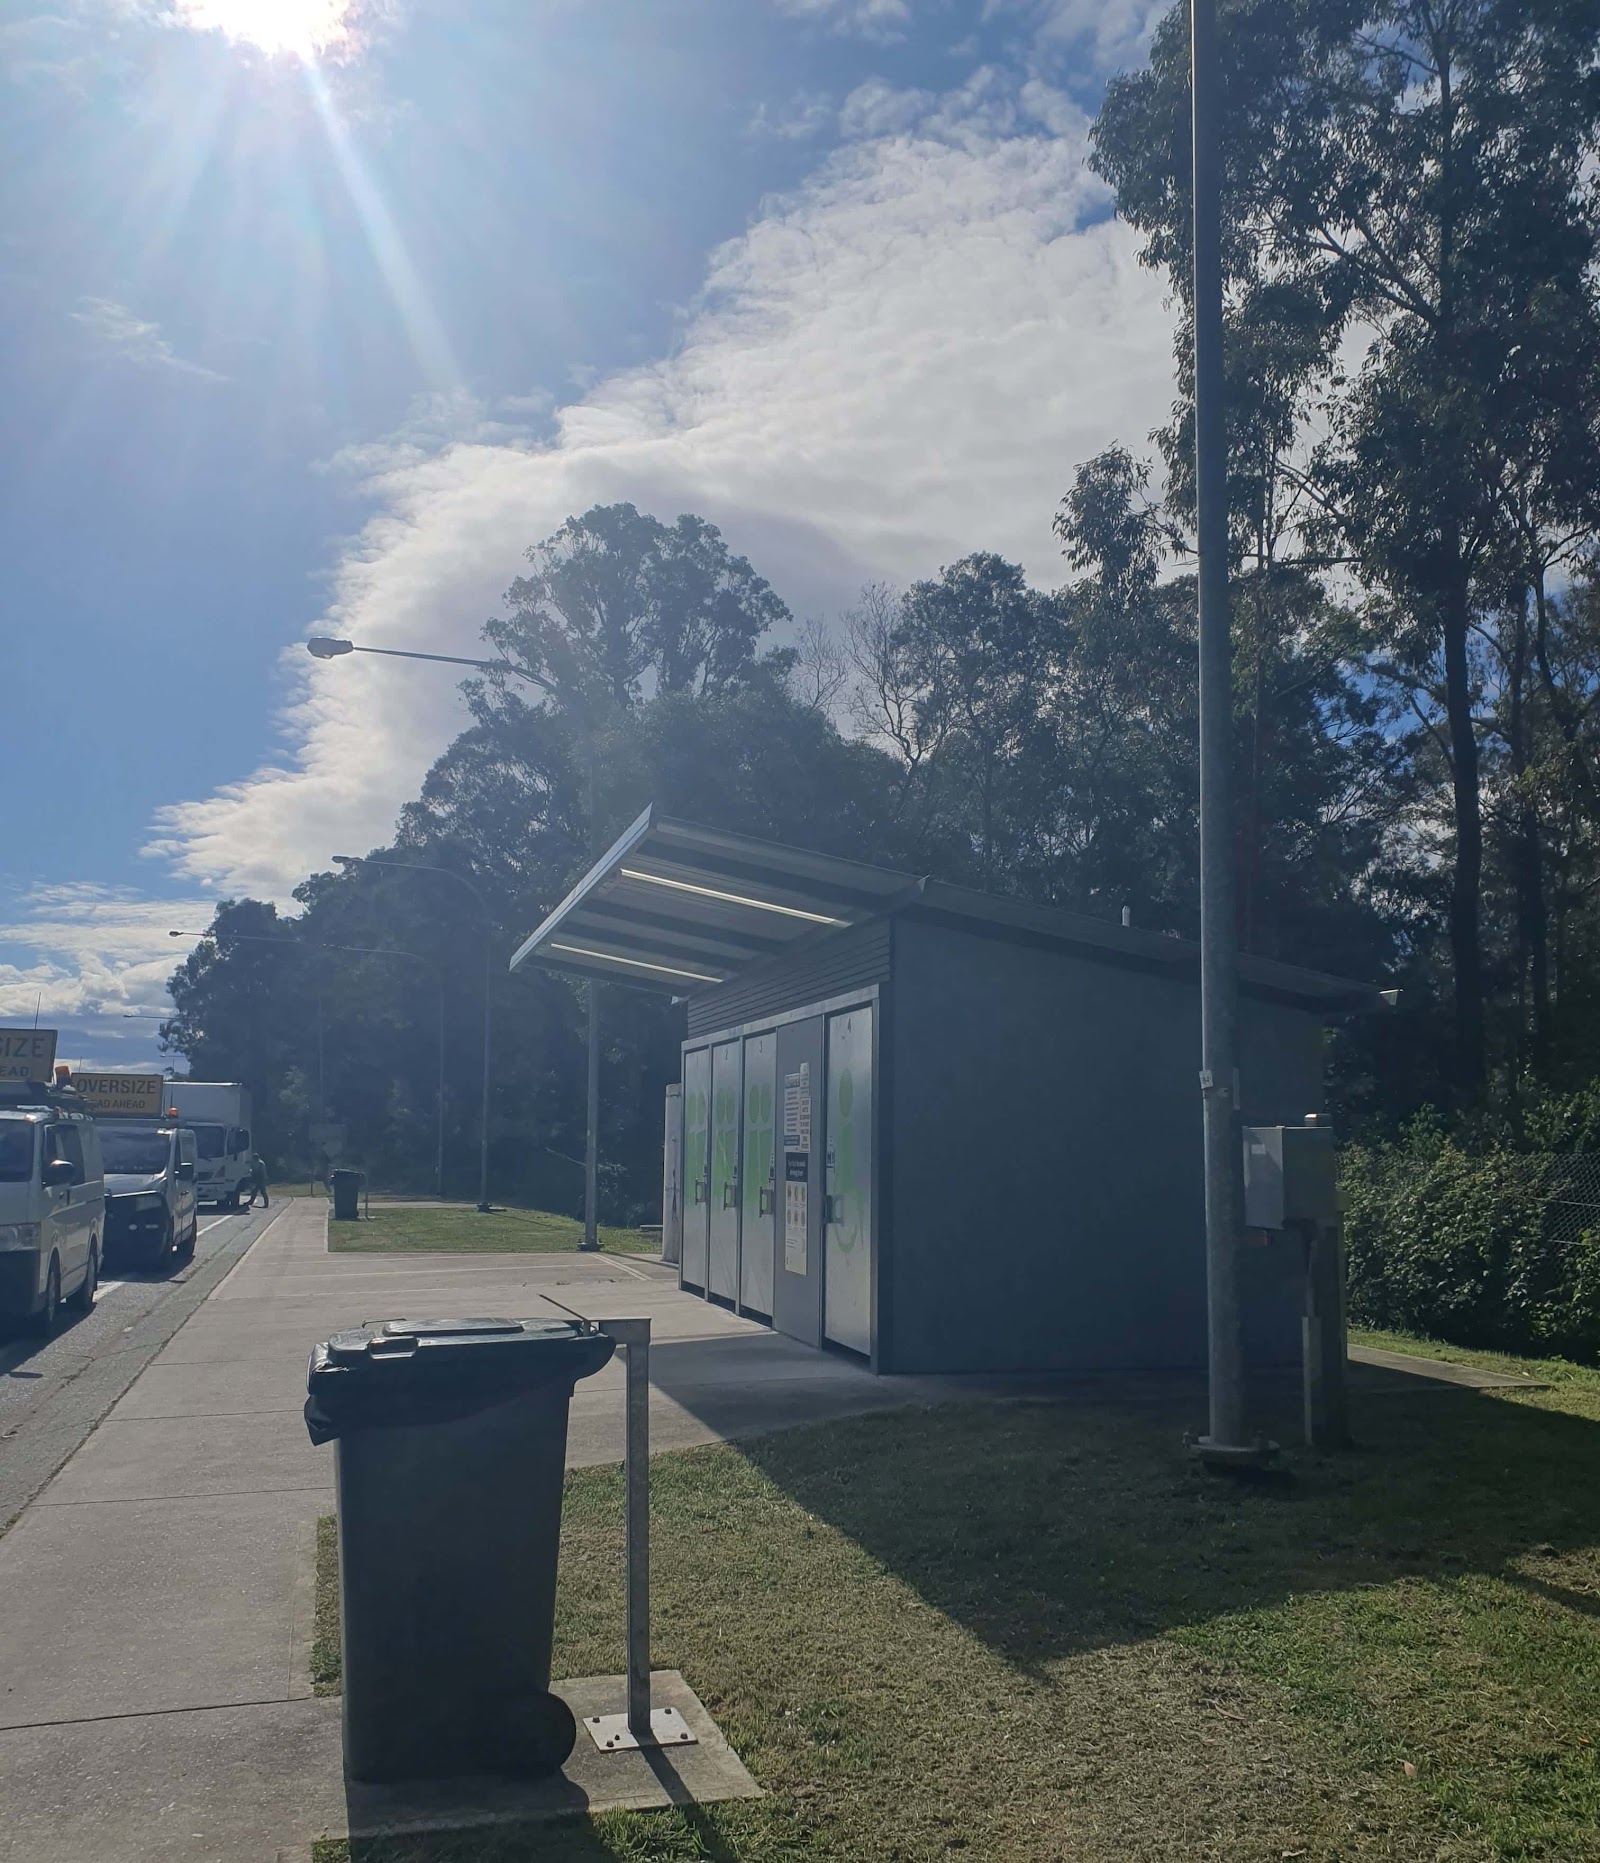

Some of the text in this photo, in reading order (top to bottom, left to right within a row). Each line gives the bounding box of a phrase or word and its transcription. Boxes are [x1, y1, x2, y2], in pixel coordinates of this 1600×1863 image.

[77, 1078, 156, 1094] OVERSIZE
[97, 1099, 146, 1109] AD AHEAD
